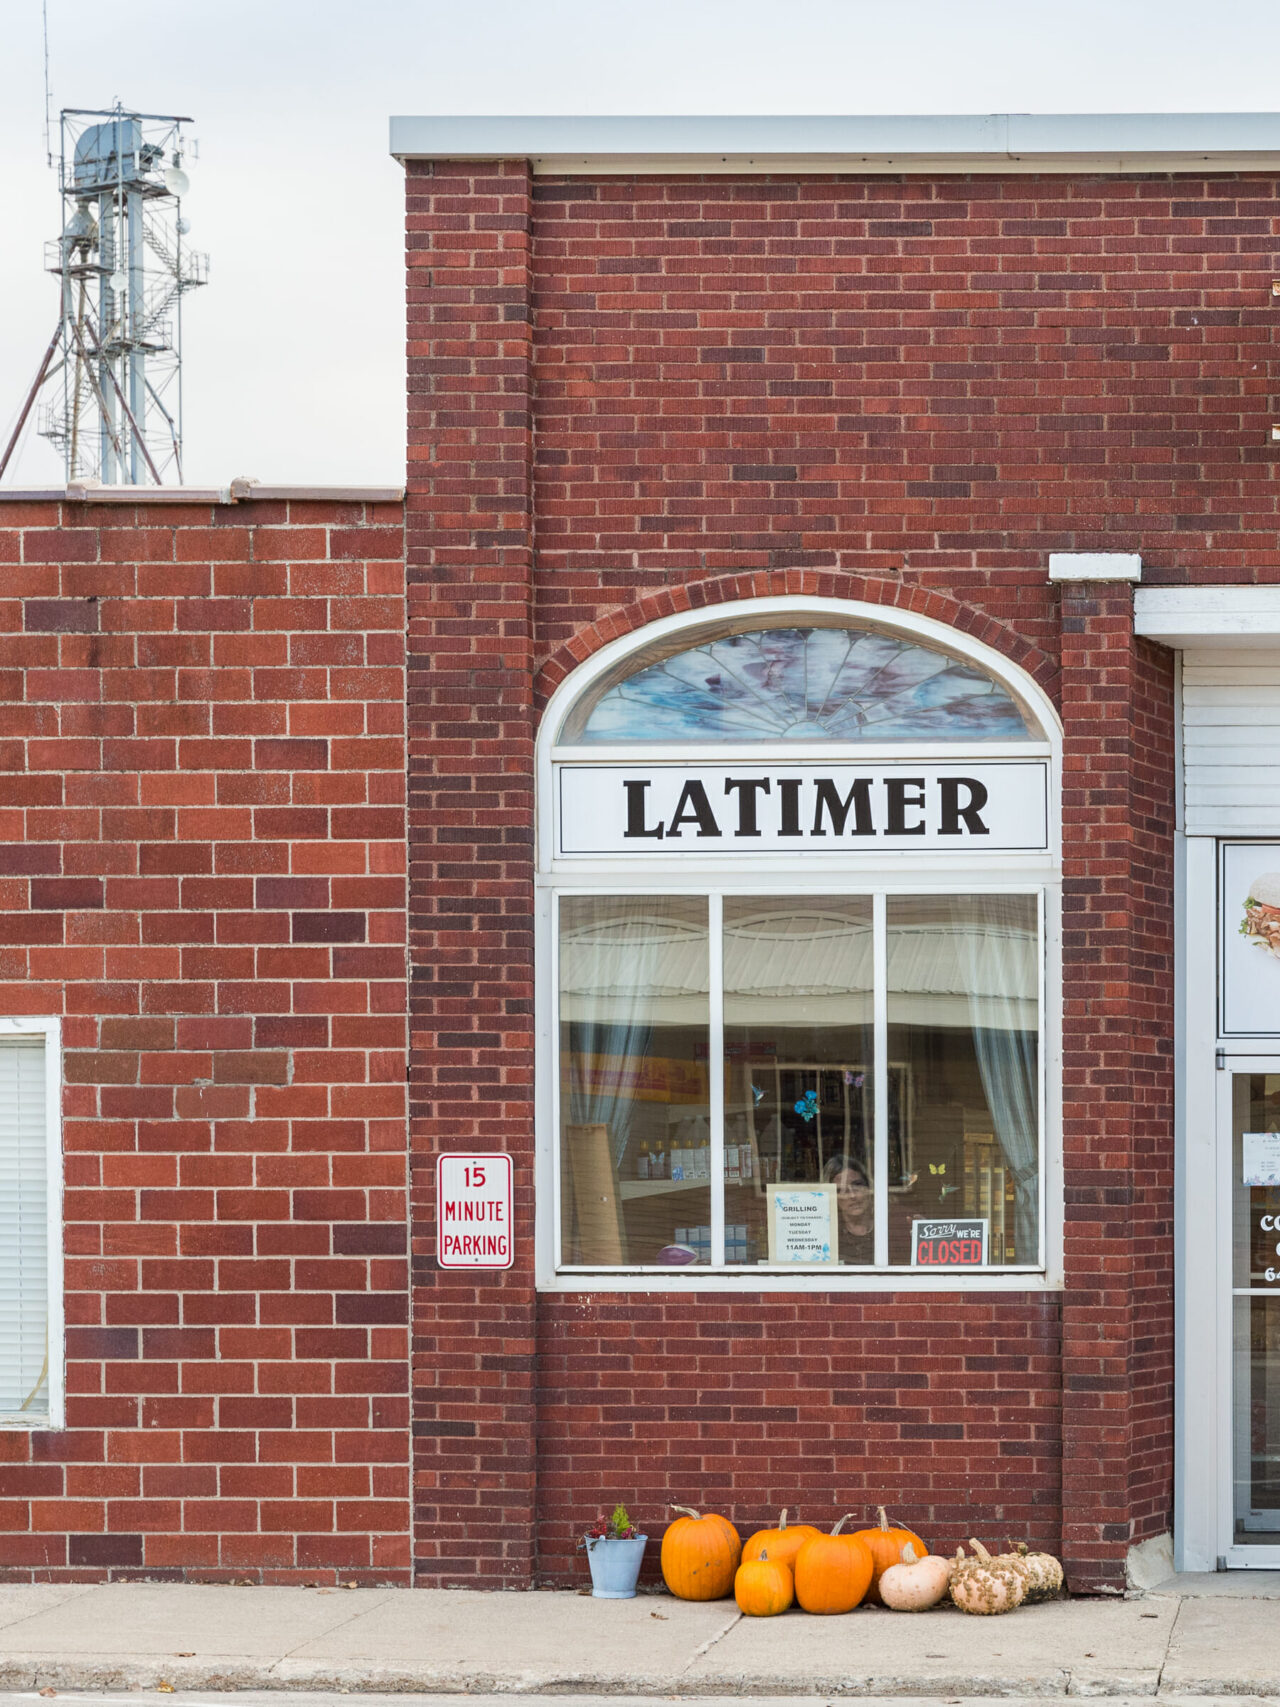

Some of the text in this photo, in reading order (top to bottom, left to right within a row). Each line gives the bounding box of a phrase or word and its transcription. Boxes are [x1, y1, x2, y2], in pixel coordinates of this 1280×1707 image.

[623, 777, 989, 840] LATIMER
[464, 1167, 486, 1188] 15
[445, 1201, 504, 1221] MINUTE
[919, 1223, 982, 1239] Sorry WE'RE
[444, 1235, 507, 1256] PARKING
[917, 1240, 982, 1264] CLOSED
